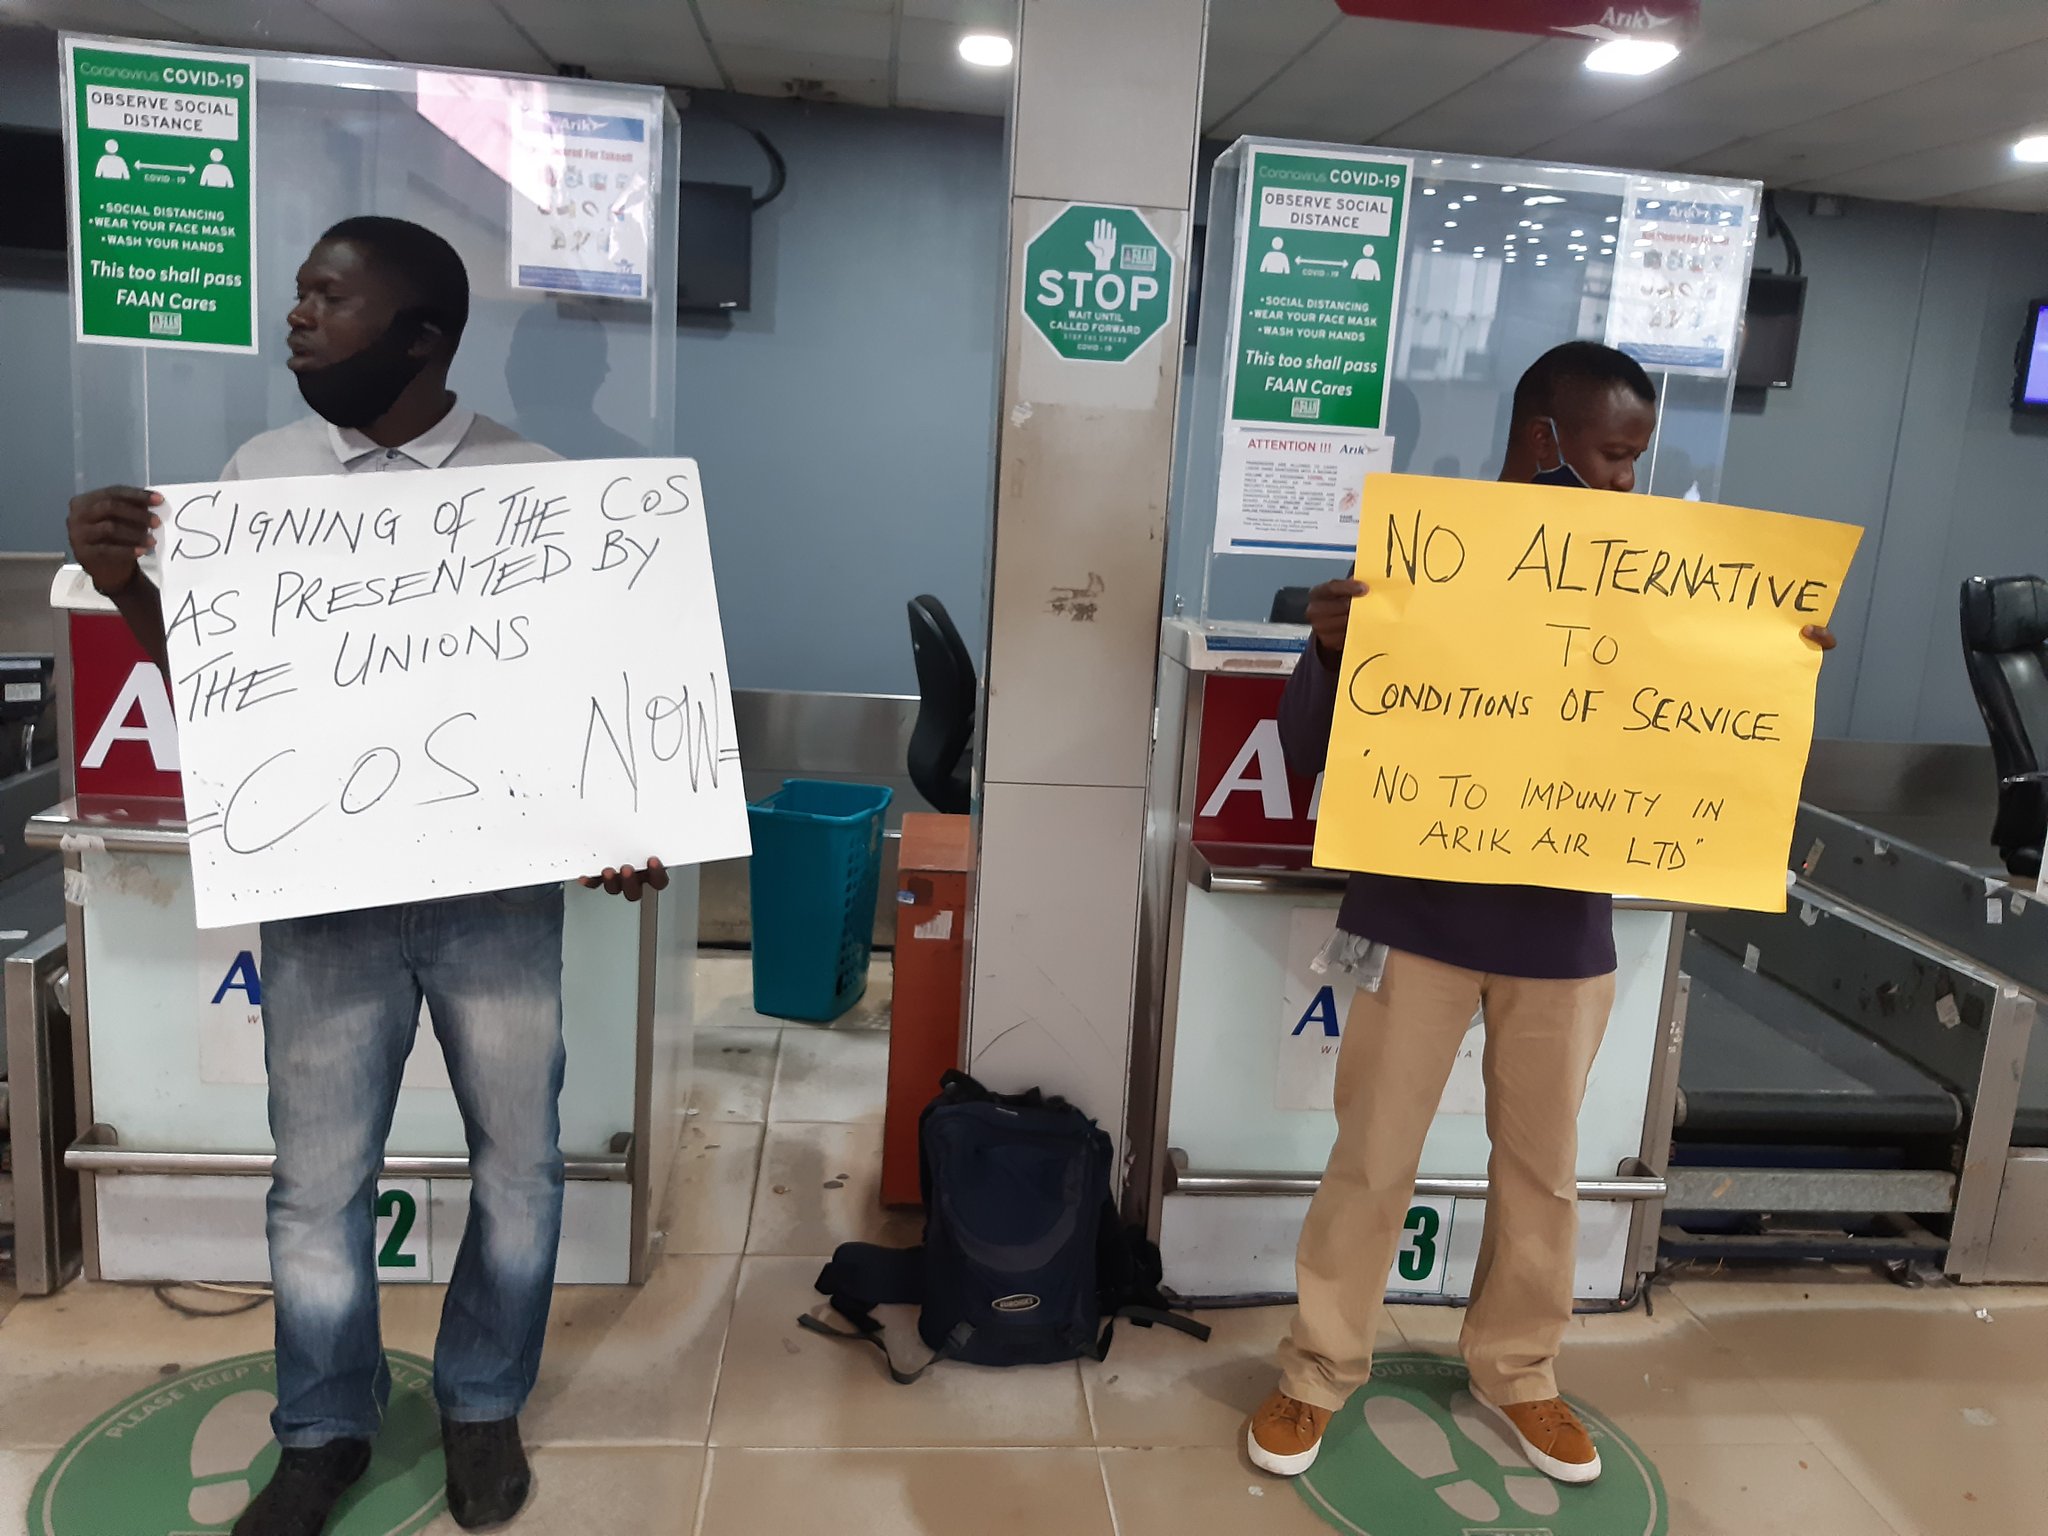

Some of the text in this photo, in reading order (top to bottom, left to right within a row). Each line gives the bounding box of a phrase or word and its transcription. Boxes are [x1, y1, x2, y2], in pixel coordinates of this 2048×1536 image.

[1600, 6, 1643, 28] Arik
[80, 62, 244, 89] Coronavirus COVID-19
[91, 91, 235, 116] OBSERVE SOCIAL
[124, 113, 203, 132] DISTANCE
[1259, 166, 1401, 189] Coronavirus COVID-19
[106, 203, 225, 221] SOCIAL DISTANCING
[1264, 193, 1388, 214] OBSERVE SOCIAL
[94, 217, 236, 237] WEAR YOUR FACE MASK
[1290, 212, 1360, 229] DISTANCE
[107, 235, 224, 253] WASH YOUR HANDS
[90, 259, 242, 288] This too shall pass
[116, 289, 217, 312] FAAN Cares
[1036, 269, 1159, 311] STOP
[1068, 310, 1124, 322] WAIT UNTIL
[1265, 296, 1370, 313] SOCIAL DISTANCING
[1050, 320, 1141, 335] CALLED FORWARD
[1254, 309, 1377, 327] WEAR YOUR FACE MASK
[1263, 326, 1365, 342] WASH YOUR HANDS
[1246, 350, 1377, 374] This too shall pass
[1264, 376, 1352, 397] FAAN Cares
[1248, 438, 1365, 455] ATTENTION !!! Arik
[171, 490, 402, 561] SIGNING
[433, 487, 486, 553] OF
[496, 486, 571, 547] THE
[1386, 509, 1828, 613] NO ALTERNATIVE
[165, 529, 660, 646] AS PRESENTED BY
[1546, 623, 1619, 667] TO
[178, 616, 530, 722] THE UNIONS
[1561, 688, 1604, 723] OF
[1439, 774, 1487, 810] TO
[1520, 778, 1662, 818] IMPUNITY
[1693, 797, 1724, 822] IN
[1419, 820, 1512, 855] ARIK
[1532, 828, 1590, 858] AIR
[376, 1189, 416, 1267] 2
[1398, 1206, 1439, 1280] 3
[106, 1366, 249, 1438] PLEASE KEEP
